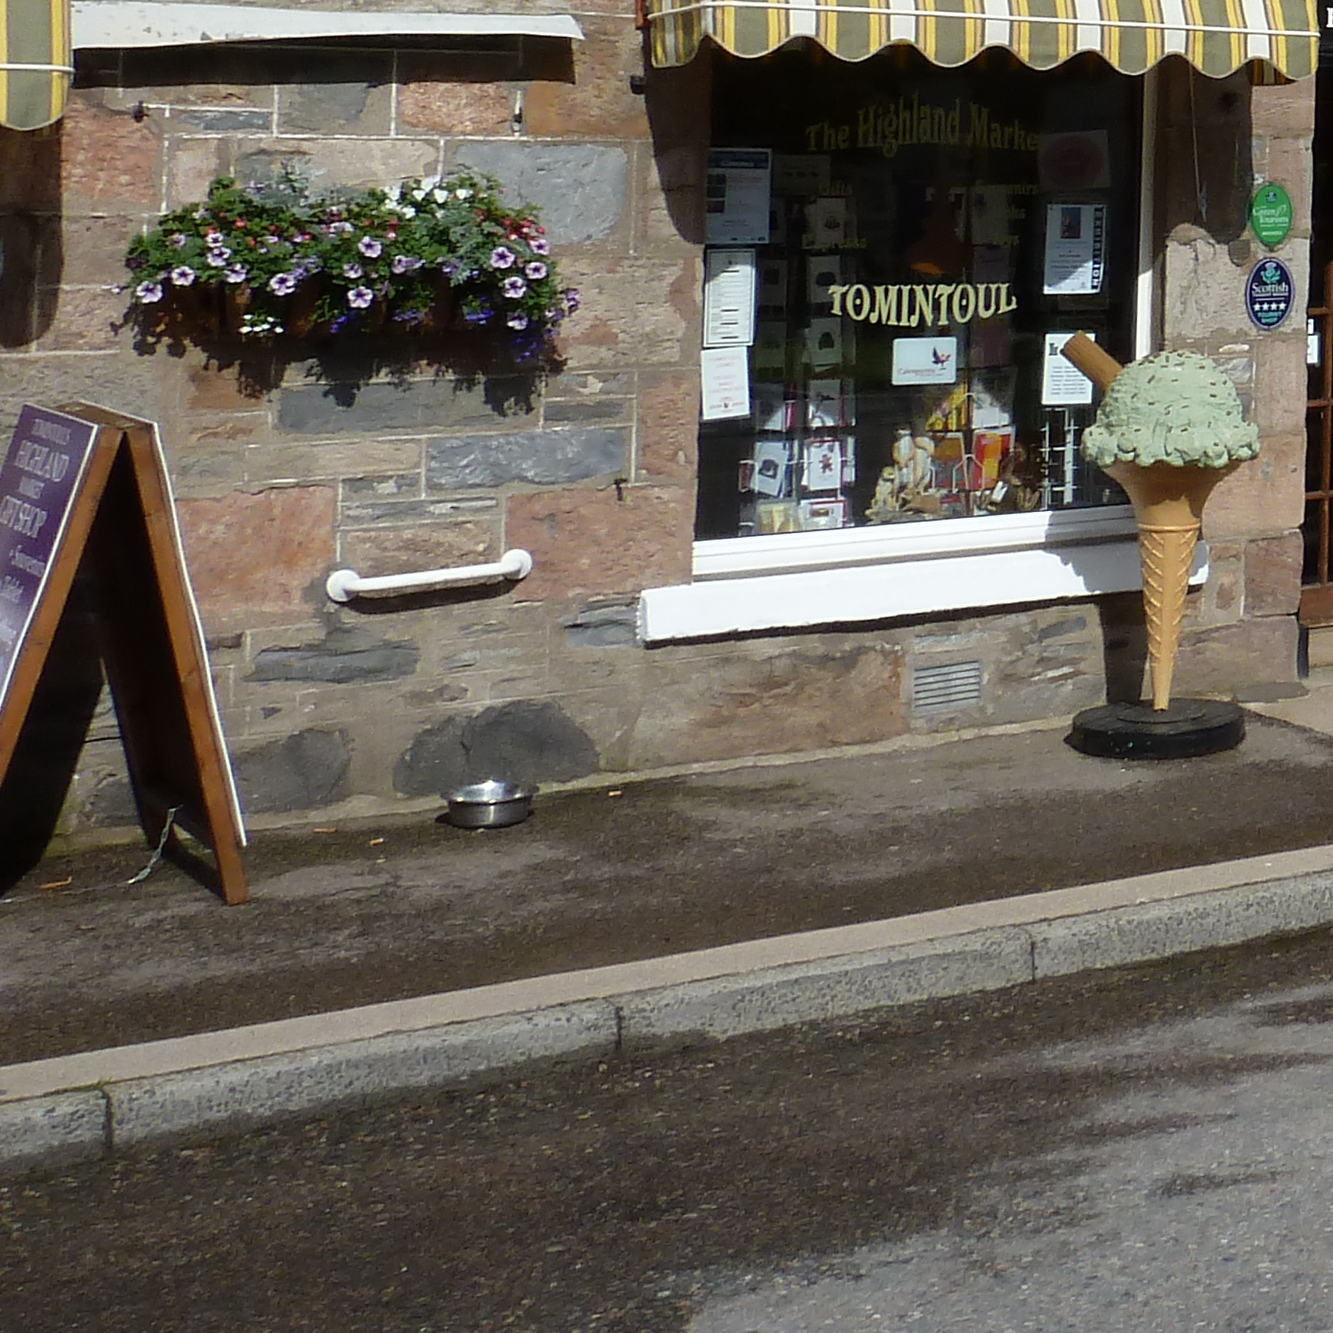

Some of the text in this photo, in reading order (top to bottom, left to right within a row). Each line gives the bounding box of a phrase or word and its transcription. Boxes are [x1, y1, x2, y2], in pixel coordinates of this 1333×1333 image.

[806, 91, 1040, 158] The Highland Marke
[828, 282, 1018, 327] TOMINTOUL
[1252, 283, 1289, 293] Scottish
